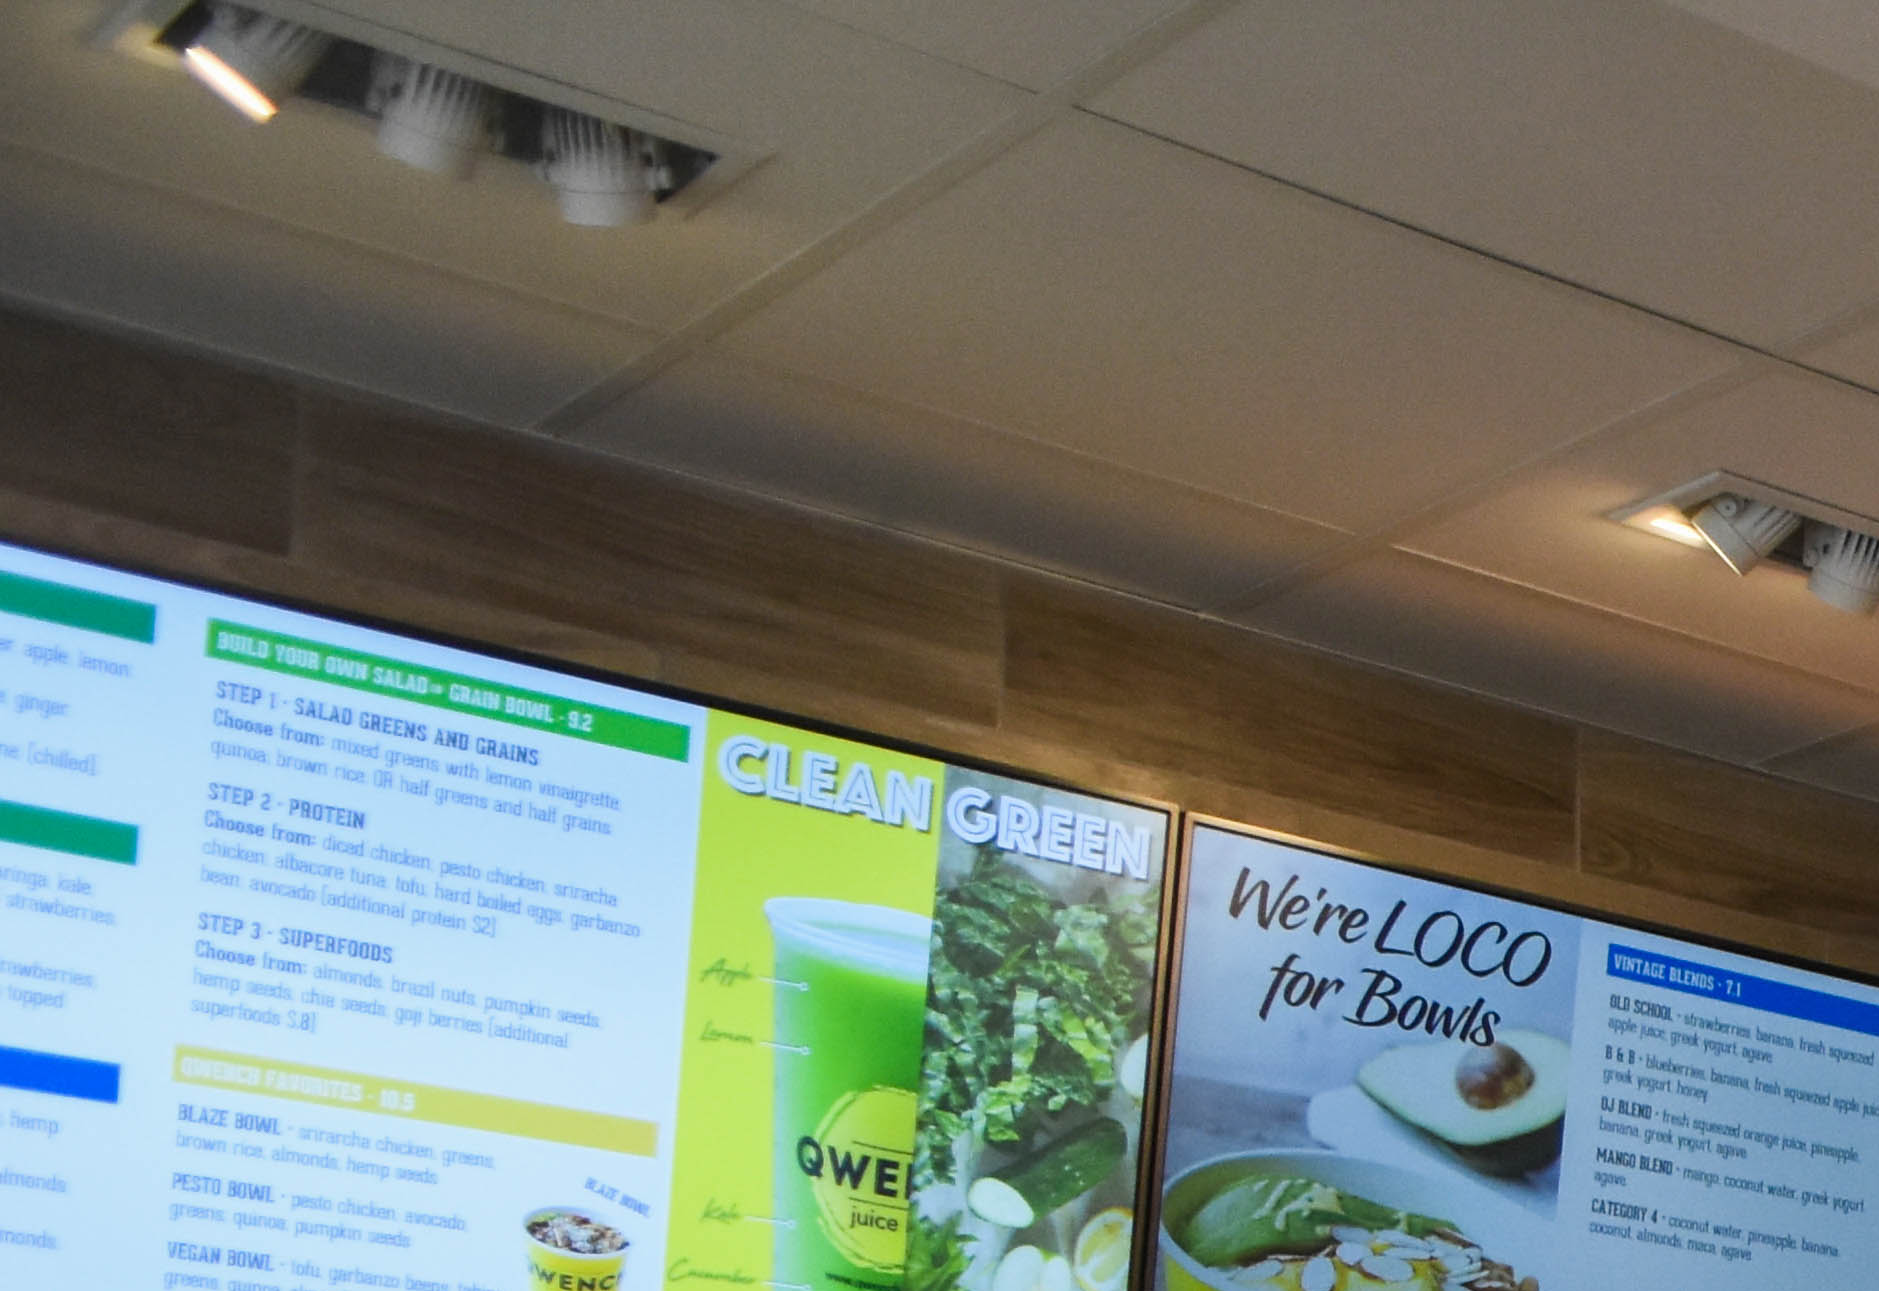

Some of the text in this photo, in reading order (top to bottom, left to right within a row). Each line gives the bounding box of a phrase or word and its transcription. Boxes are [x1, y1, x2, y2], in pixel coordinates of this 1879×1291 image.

[215, 629, 594, 734] BUILD YOUR OWN SALAD GRAIN BOWL 9.2
[214, 678, 541, 768] STEP 1 SALAD GREENS AND GRAINS
[211, 707, 276, 739] Choose
[330, 733, 381, 761] mixed
[383, 748, 440, 779] greens
[444, 757, 481, 782] with
[483, 766, 534, 793] lemon
[202, 808, 267, 838] Choose
[206, 780, 367, 832] STEP 2 PROTEIN
[721, 736, 1151, 879] CLEAN GREEN
[196, 910, 395, 966] STEP 3 SUPERFOODS
[1229, 867, 1552, 988] We're LOCO
[192, 939, 258, 967] Choose
[1612, 952, 1743, 999] VINTAGE BLENDS 7.1
[1258, 952, 1503, 1048] for Bowls
[1608, 992, 1675, 1024] OLD SCHOOL
[1603, 1043, 1637, 1066] B & B
[176, 1102, 282, 1136] BLAZE BOWL
[1598, 1094, 1654, 1121] OJ BLEND
[1593, 1145, 1674, 1177] MANGO BLEND
[170, 1171, 277, 1205] PESTO BOWL
[847, 1206, 898, 1233] juice
[1588, 1196, 1660, 1226] CATEGORY 4
[165, 1241, 275, 1273] VEGAN BOWL
